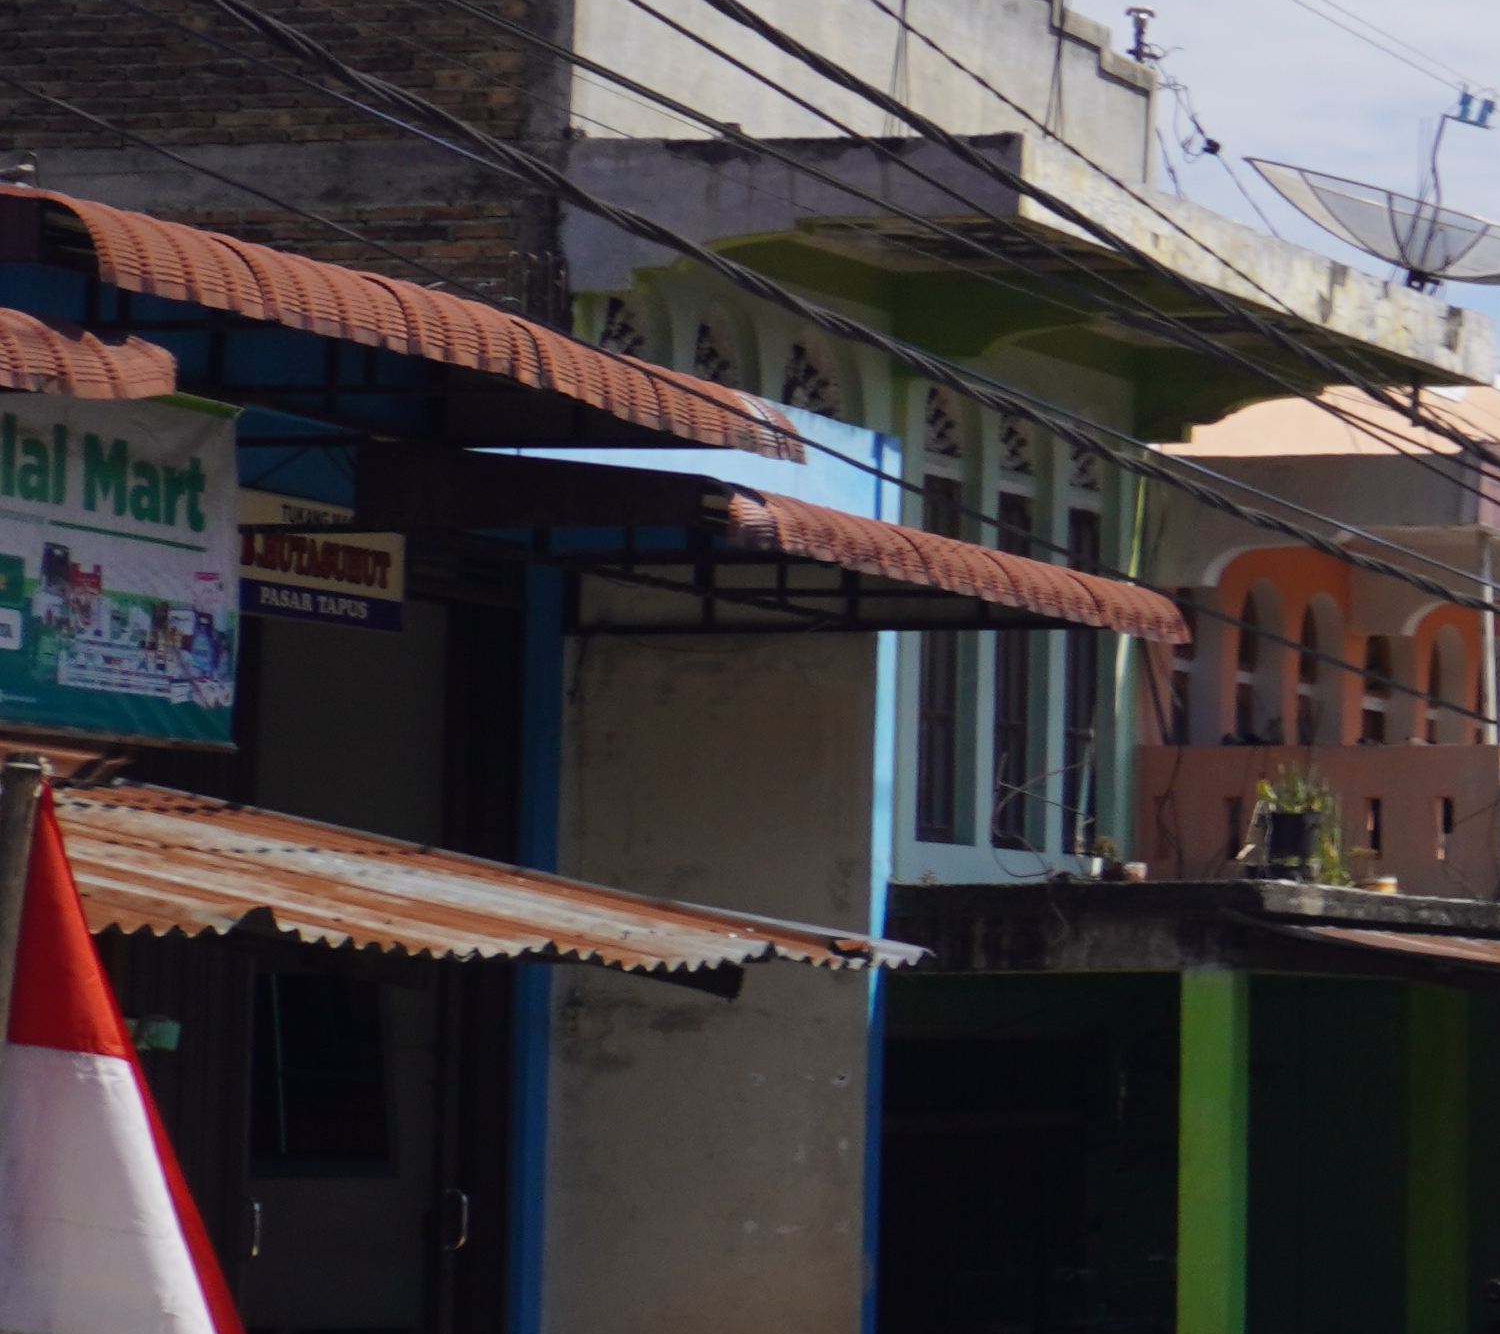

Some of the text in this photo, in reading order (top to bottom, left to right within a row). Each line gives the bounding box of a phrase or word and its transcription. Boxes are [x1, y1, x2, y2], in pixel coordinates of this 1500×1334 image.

[83, 432, 205, 533] Mart
[260, 585, 369, 620] PASAR TAPUS
